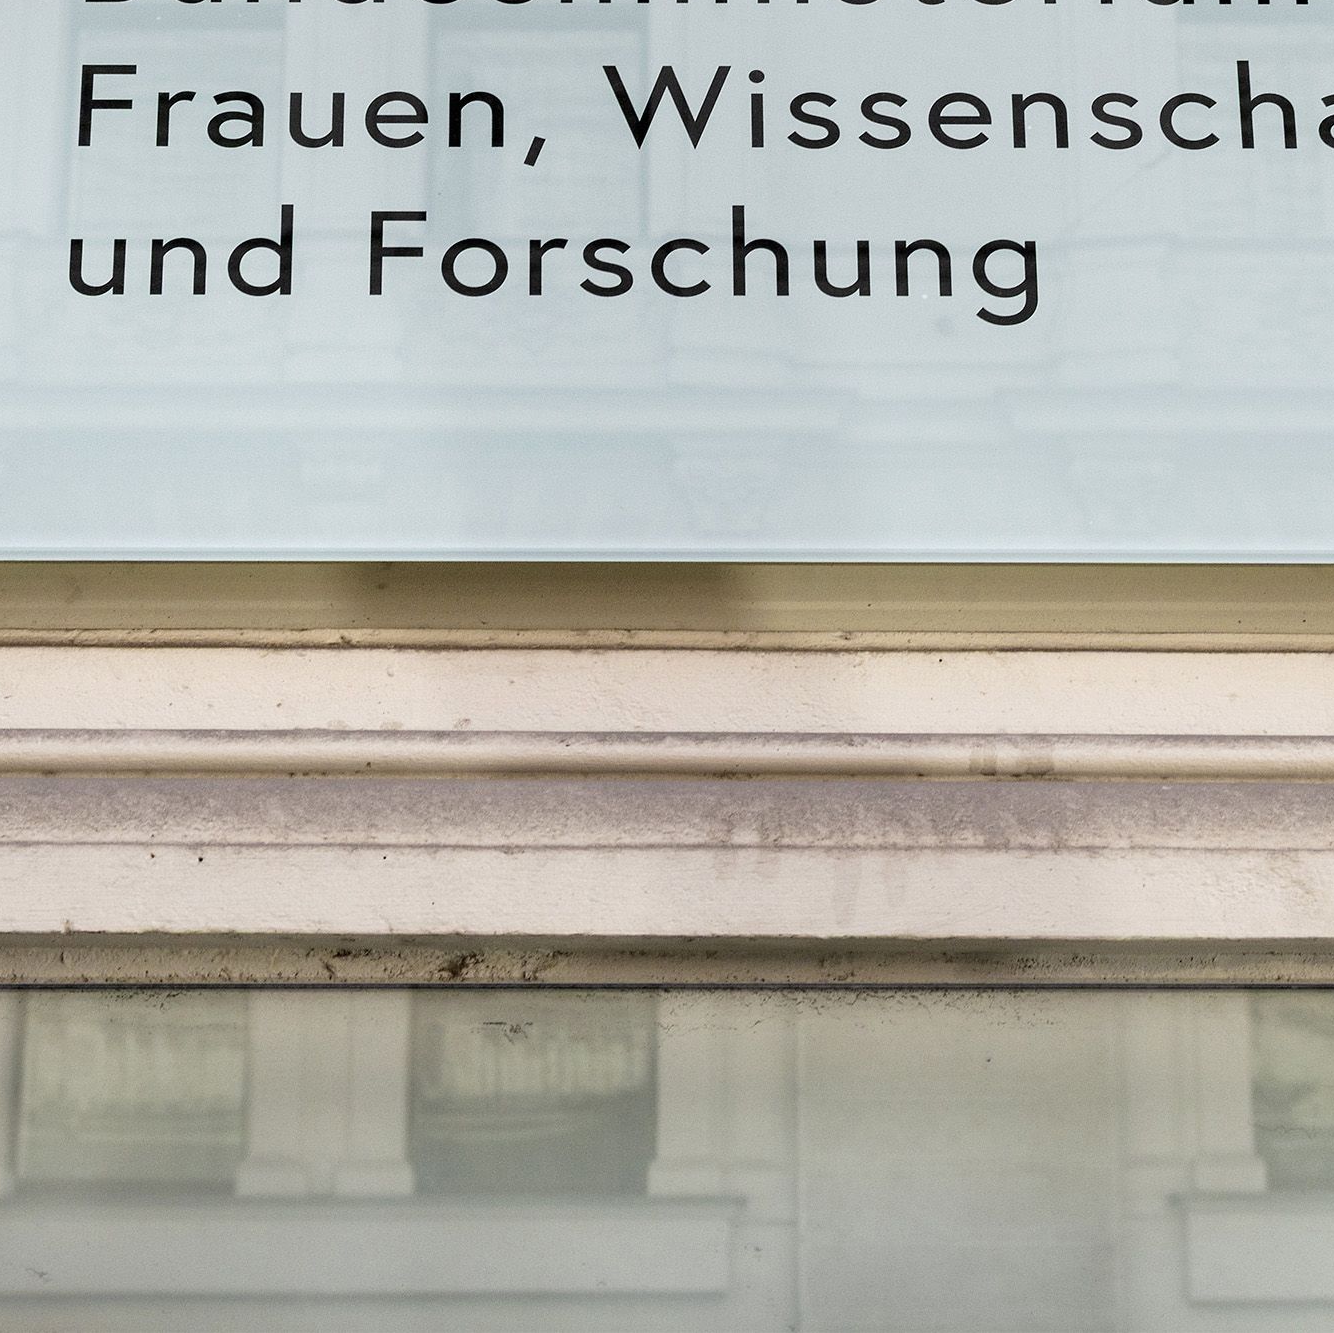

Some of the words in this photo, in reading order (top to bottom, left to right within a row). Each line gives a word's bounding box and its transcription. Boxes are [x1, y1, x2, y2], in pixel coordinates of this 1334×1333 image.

[77, 64, 547, 168] Frauen,
[68, 204, 294, 298] und
[369, 204, 1040, 327] Forschung
